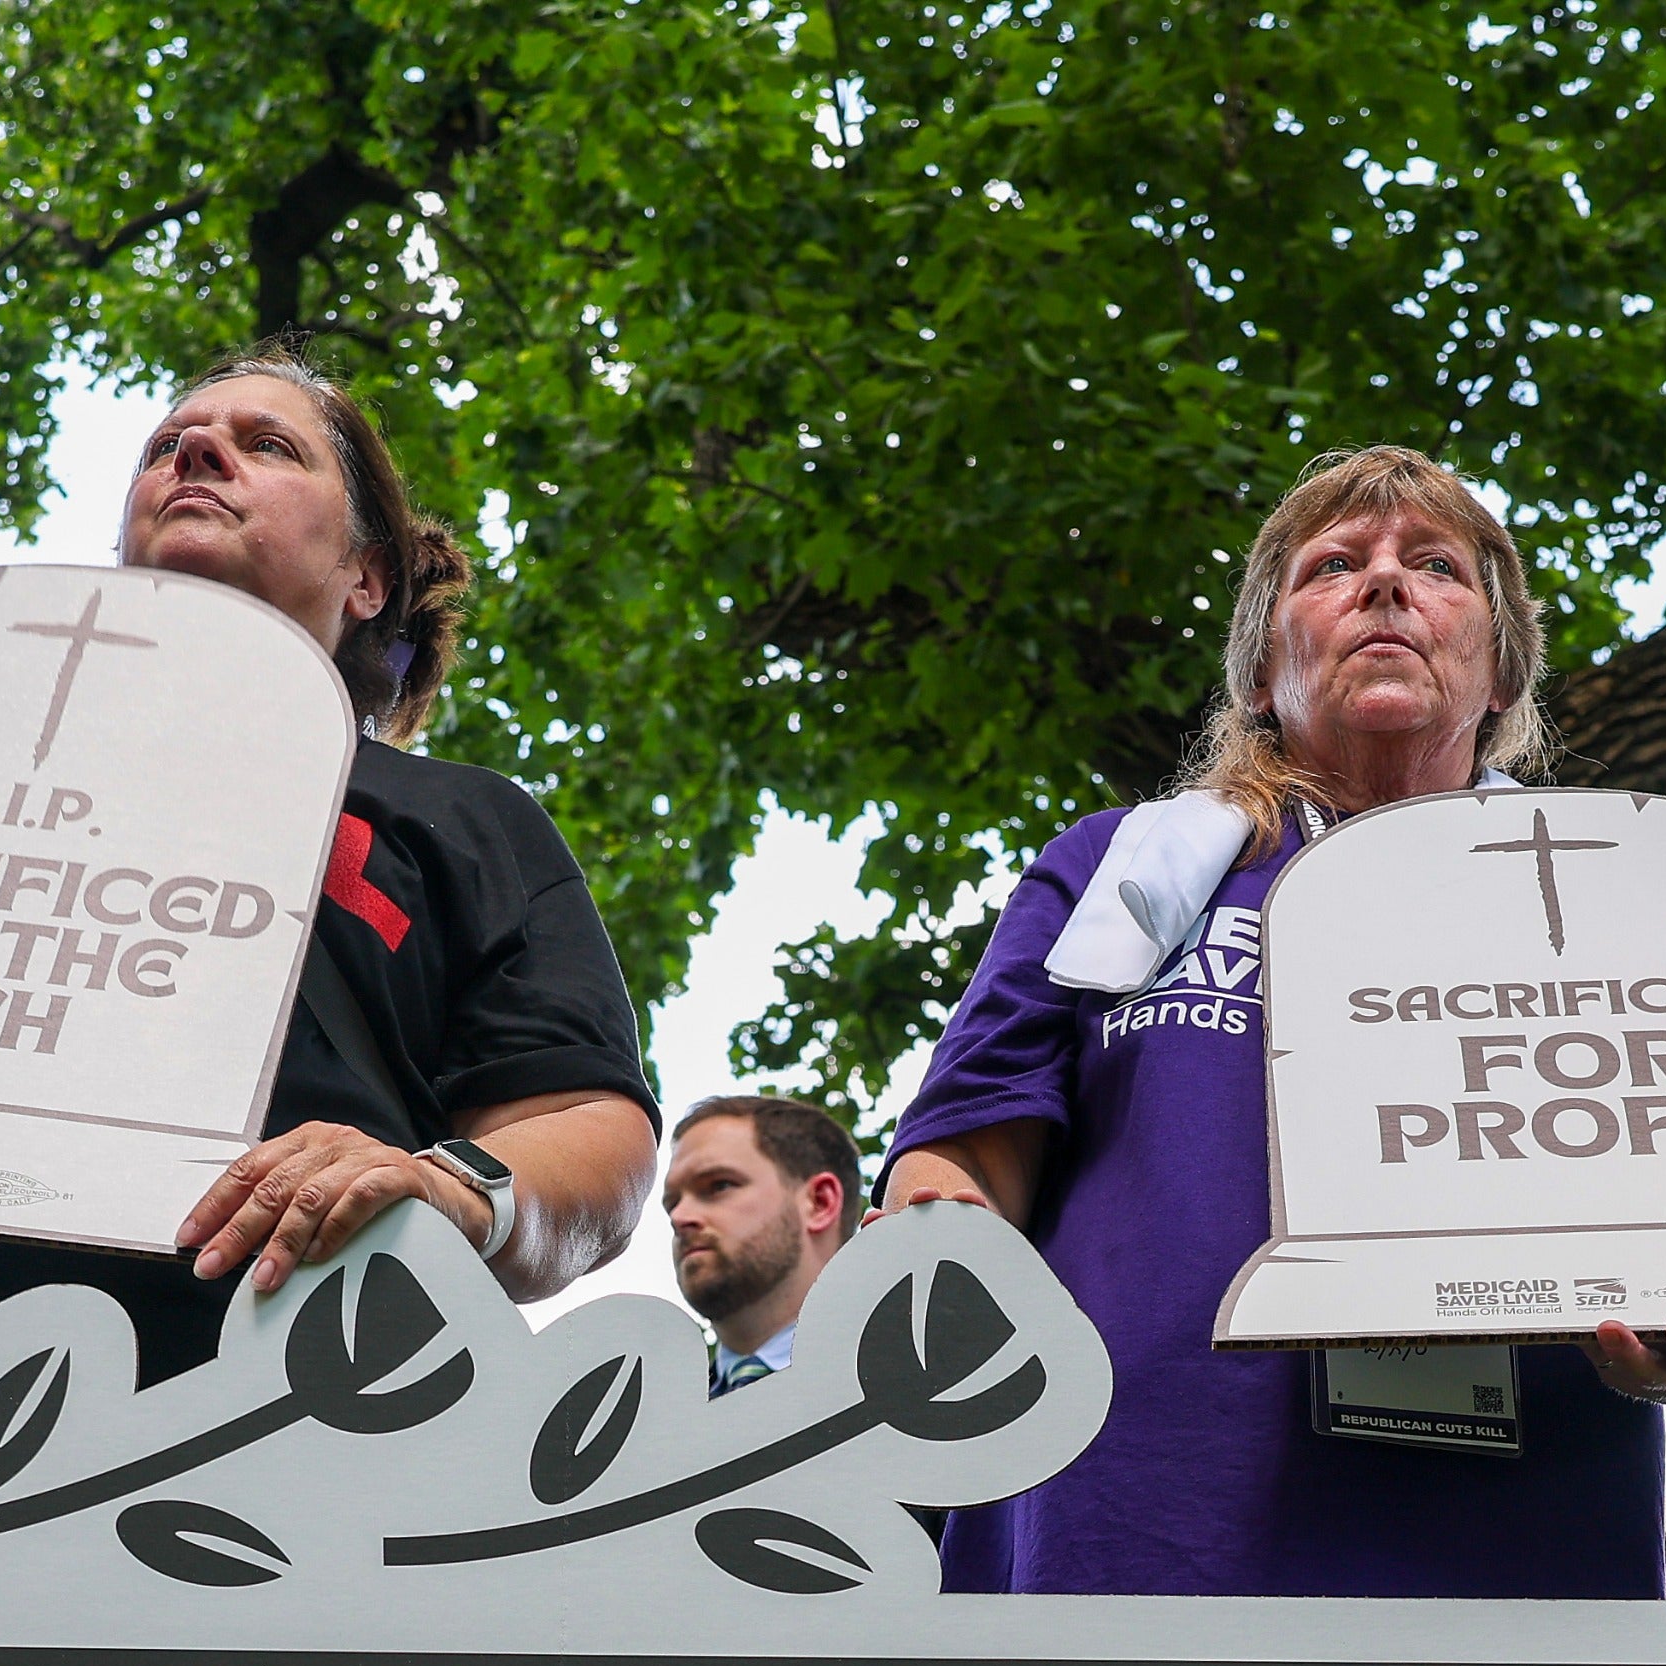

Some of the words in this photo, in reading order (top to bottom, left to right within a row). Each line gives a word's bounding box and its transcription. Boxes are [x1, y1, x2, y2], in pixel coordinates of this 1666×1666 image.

[1102, 999, 1249, 1049] Hands
[1434, 1279, 1559, 1295] MEDICAID
[1436, 1294, 1501, 1307] SAVES
[1504, 1292, 1561, 1304] LIVES
[1575, 1294, 1627, 1306] SEIU
[1437, 1308, 1479, 1318] Hands
[1480, 1306, 1502, 1316] Off
[1503, 1305, 1563, 1316] Medicaid
[1340, 1414, 1432, 1432] REPUBLICAN
[1436, 1423, 1473, 1435] CUTS
[1476, 1426, 1508, 1438] KILL
